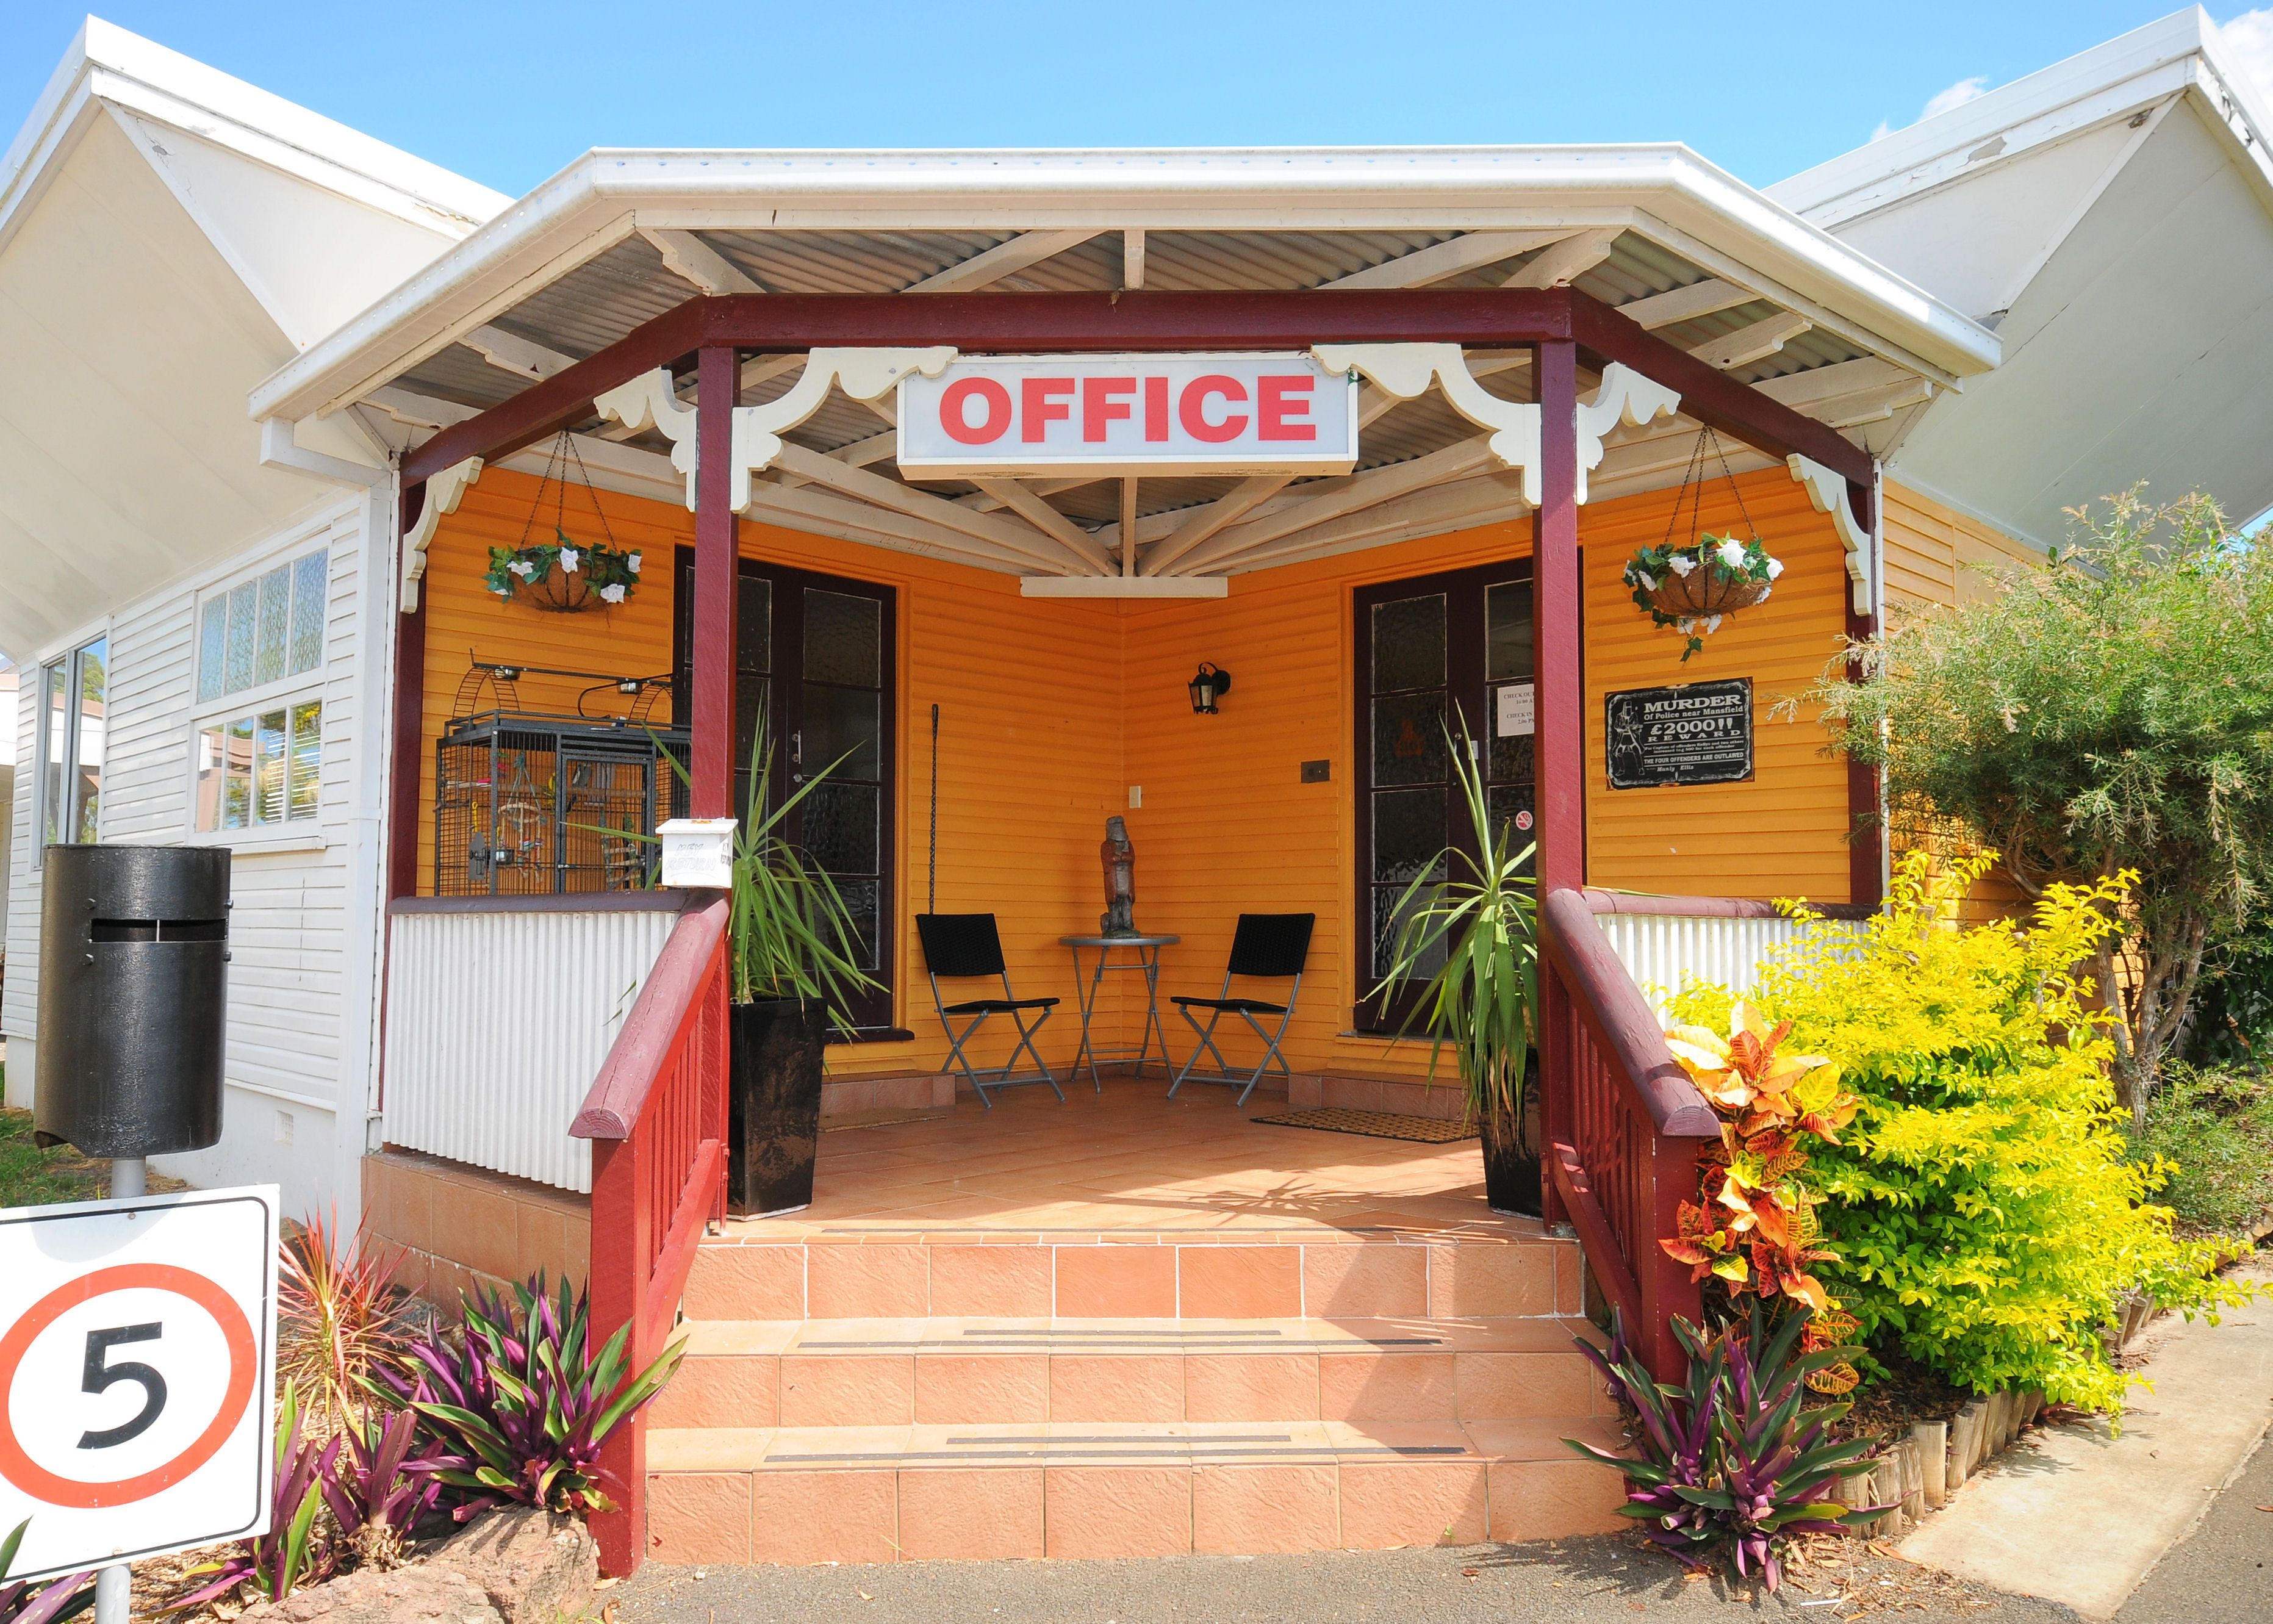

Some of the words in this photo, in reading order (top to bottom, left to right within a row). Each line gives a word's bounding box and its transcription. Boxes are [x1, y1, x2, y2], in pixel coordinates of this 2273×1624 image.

[938, 375, 1317, 445] OFFICE
[1643, 694, 1742, 713] MURDER
[1703, 705, 1743, 716] Mansfield
[674, 843, 703, 856] KEY
[664, 857, 717, 871] RETURN
[76, 1321, 167, 1449] 5
